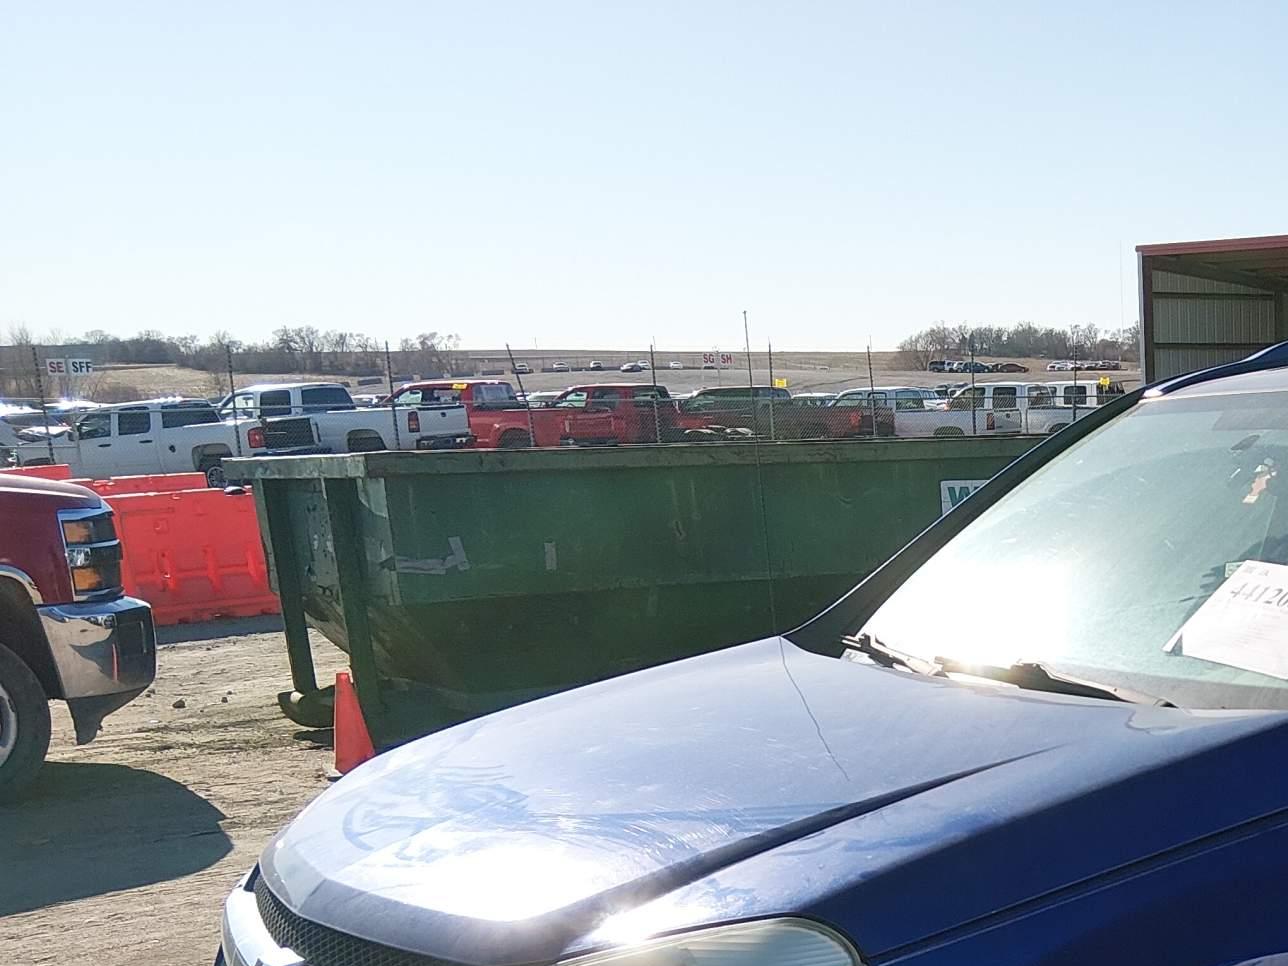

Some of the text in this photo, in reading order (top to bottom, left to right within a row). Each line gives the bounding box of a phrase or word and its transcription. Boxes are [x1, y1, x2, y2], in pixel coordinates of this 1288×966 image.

[703, 353, 715, 364] SG
[48, 361, 65, 373] SE
[71, 361, 93, 373] SFF
